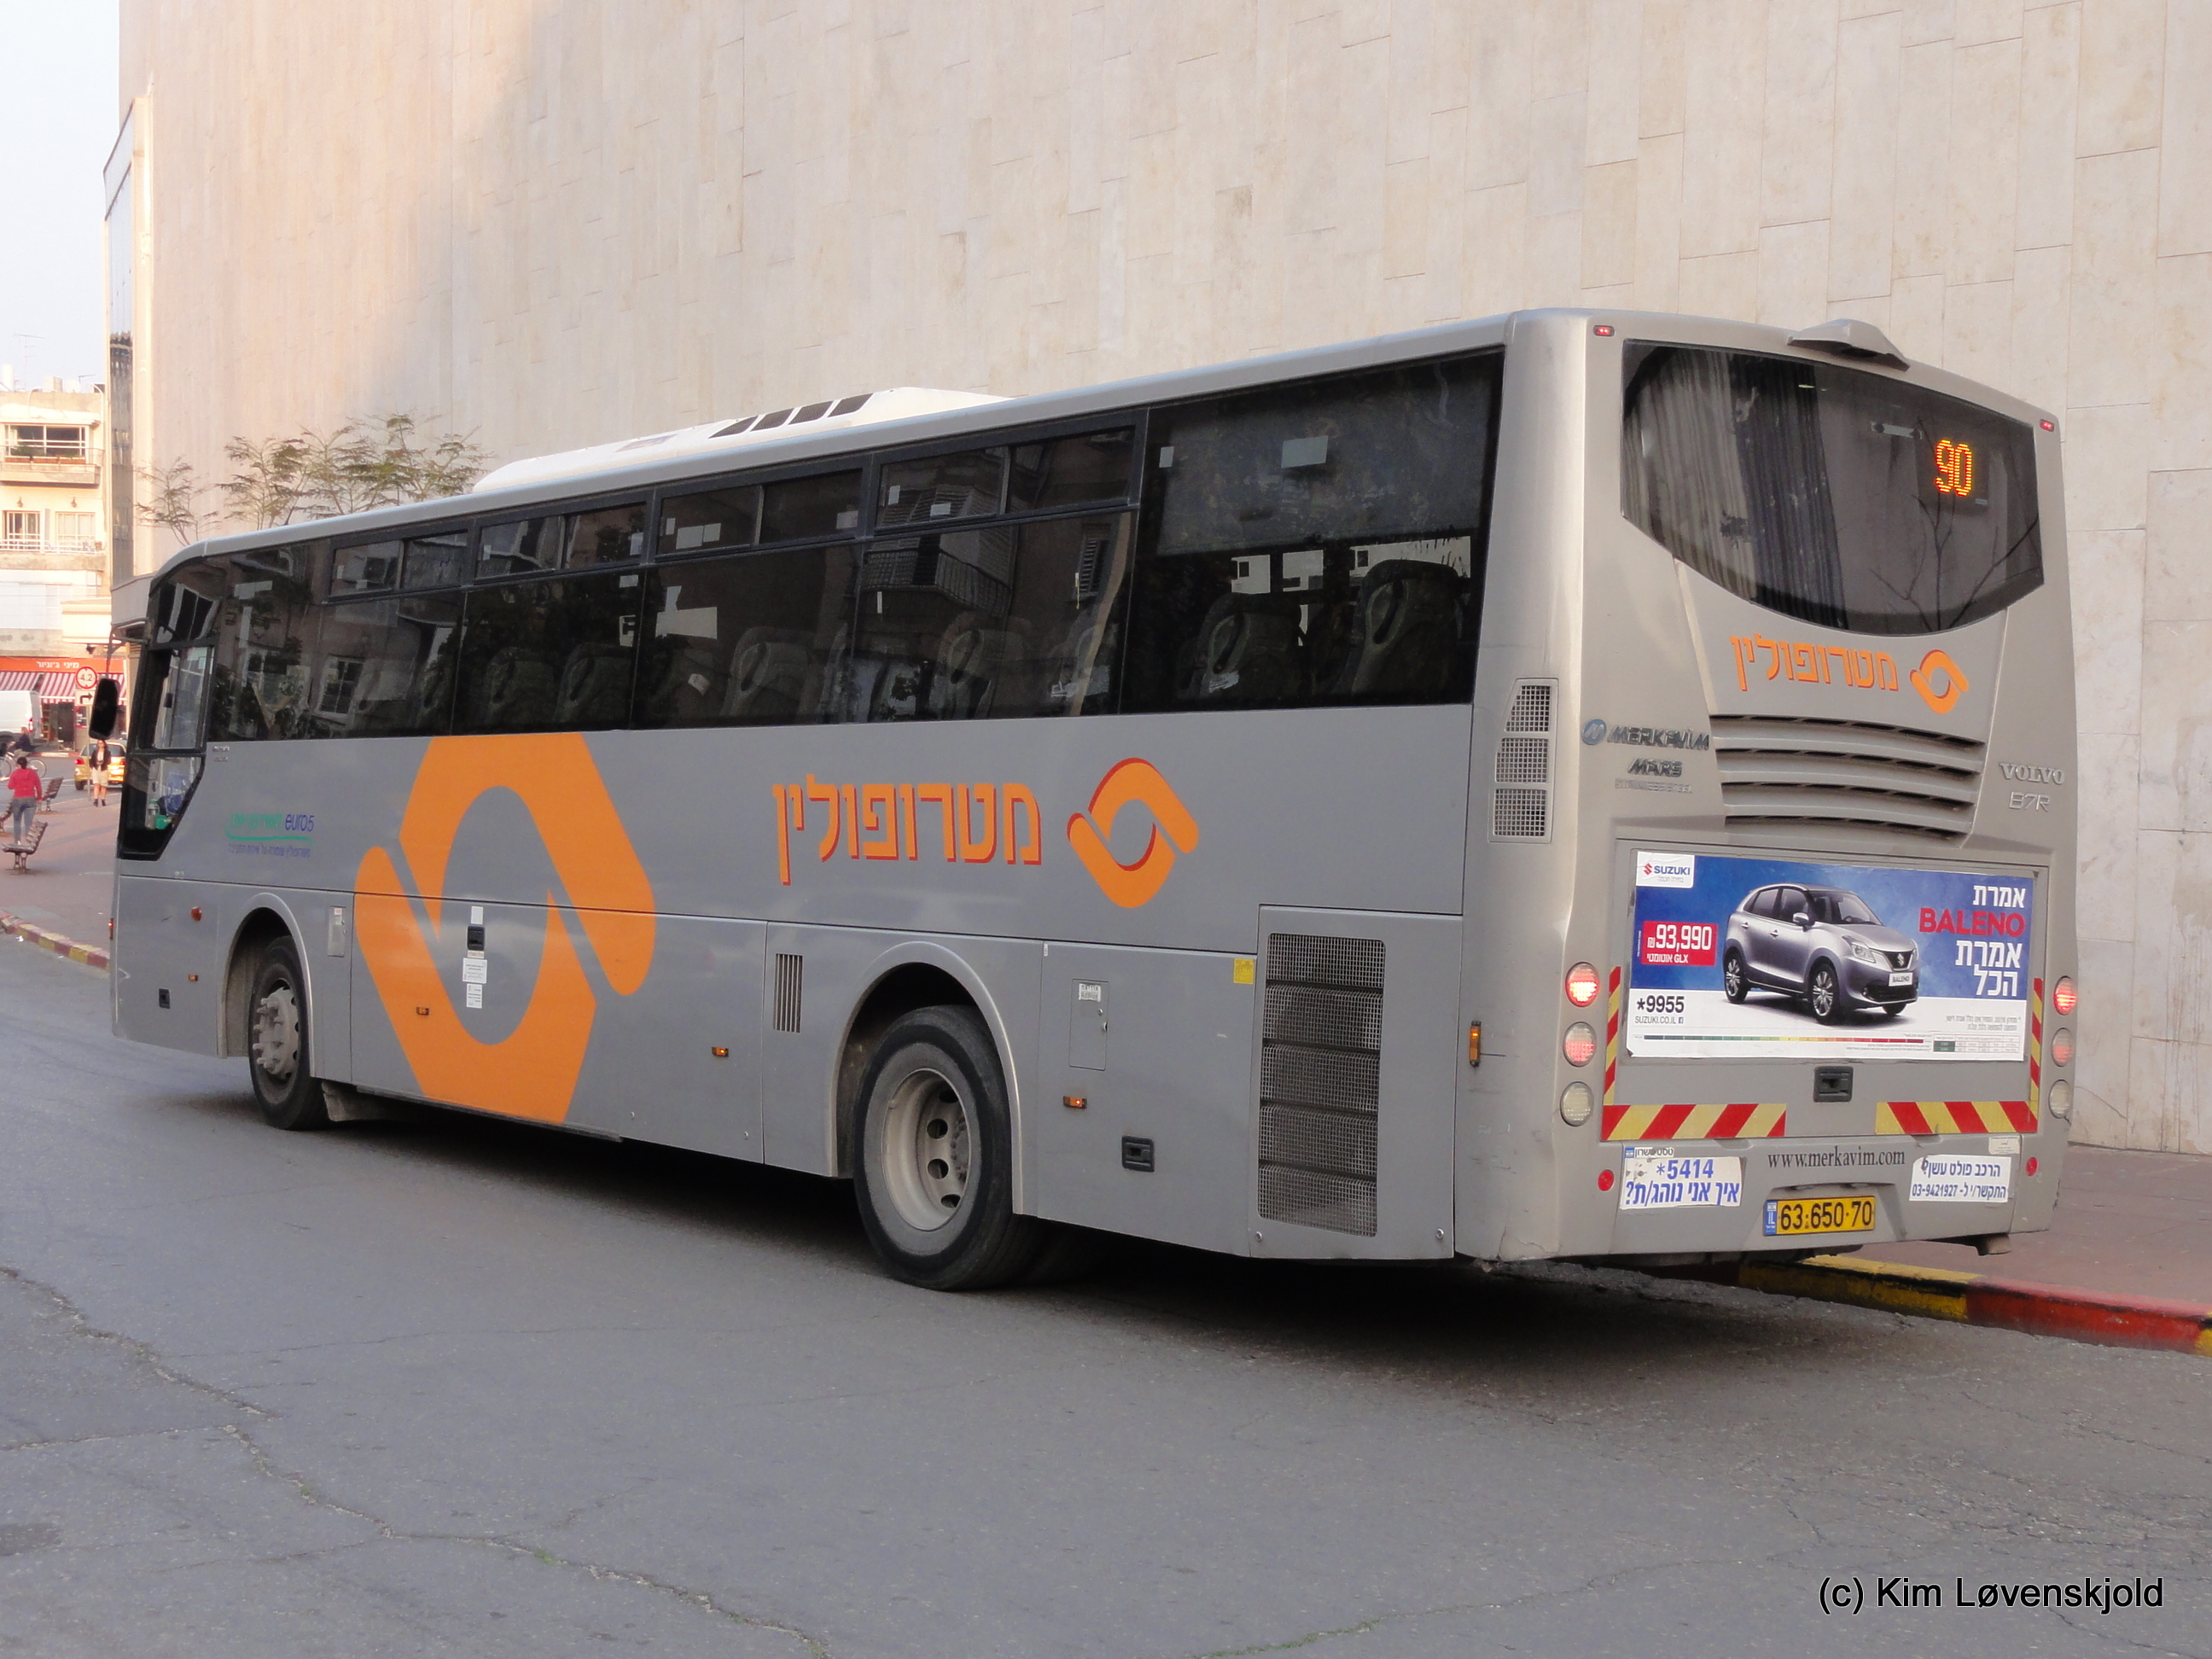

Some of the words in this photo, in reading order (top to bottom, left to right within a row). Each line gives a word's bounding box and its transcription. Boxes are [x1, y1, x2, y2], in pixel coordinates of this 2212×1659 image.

[1935, 439, 1971, 496] 90
[1729, 632, 1899, 693] מטרופולין
[1607, 725, 1710, 751] MERKAVIM
[1627, 757, 1683, 778] MARS
[1999, 762, 2065, 785] VOLVO
[2008, 791, 2050, 812] B7R
[285, 813, 315, 833] euro5
[772, 774, 1042, 886] מטרופולין
[1654, 865, 1691, 876] SUZUKI
[1972, 885, 2026, 909] אמרת
[1918, 907, 2025, 938] BALENO
[1674, 953, 1689, 963] GLX
[1955, 940, 2023, 969] אמרת
[1973, 963, 2018, 997] הכל
[1634, 1016, 1676, 1024] SUZUKI.CO.IL
[1767, 1146, 1905, 1168] www.merkavim.com
[1949, 1160, 1972, 1177] פולט
[1974, 1163, 2001, 1178] הרכב
[1687, 1181, 1711, 1202] אני
[1715, 1182, 1740, 1206] איך
[1912, 1183, 1959, 1197] 03-9421927
[1767, 1211, 1776, 1225] IL
